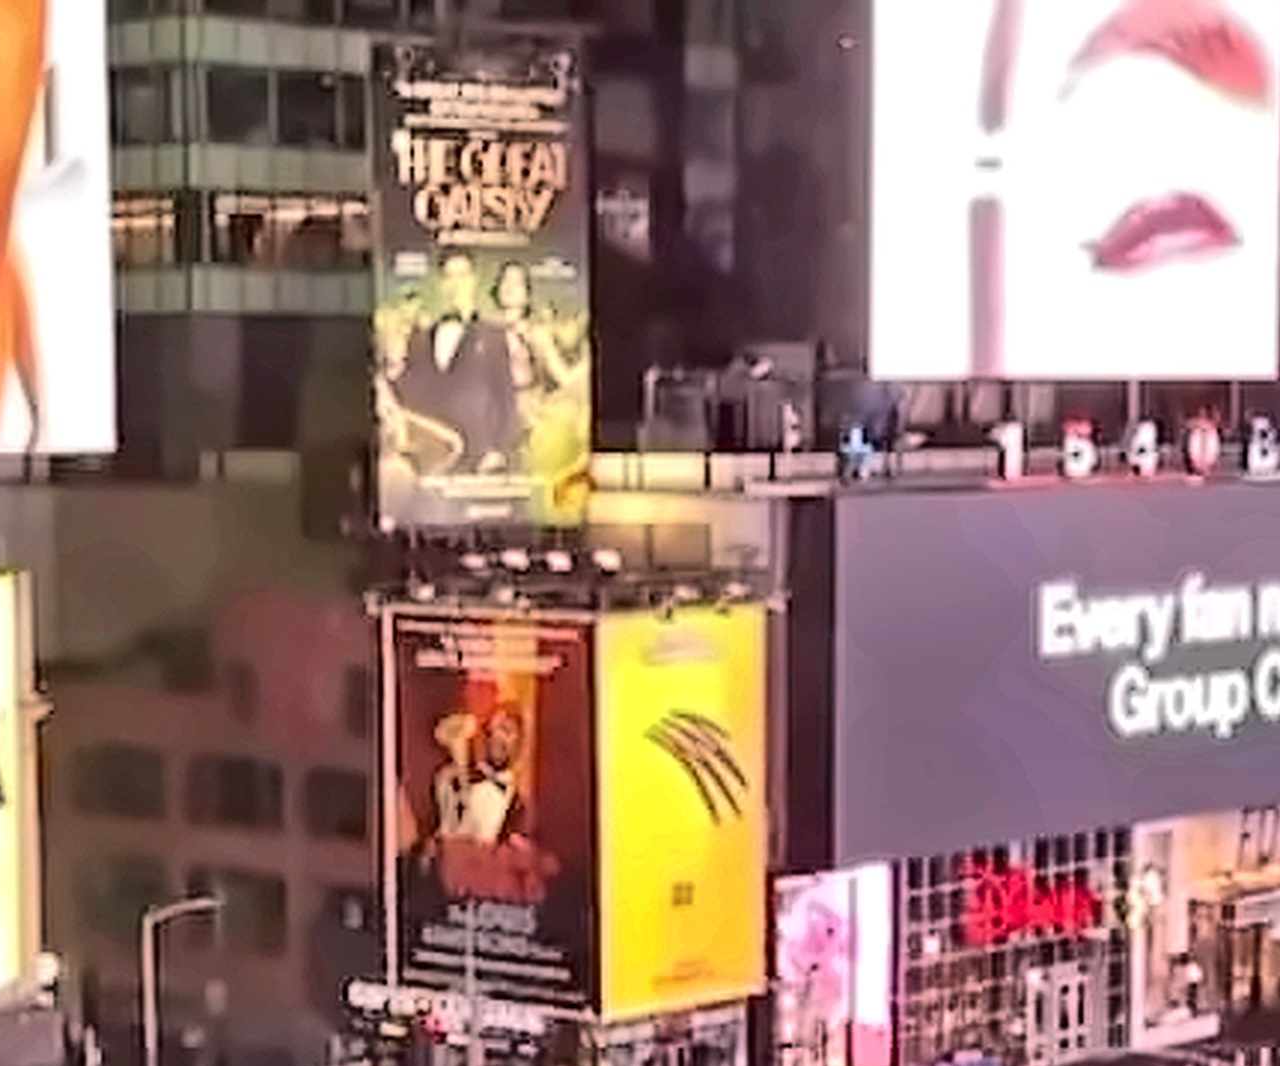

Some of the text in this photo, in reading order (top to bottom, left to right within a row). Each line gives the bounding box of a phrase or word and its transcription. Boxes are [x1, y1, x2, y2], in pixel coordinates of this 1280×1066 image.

[1041, 580, 1174, 660] Every
[1181, 571, 1252, 642] fan
[1110, 665, 1250, 738] Group
